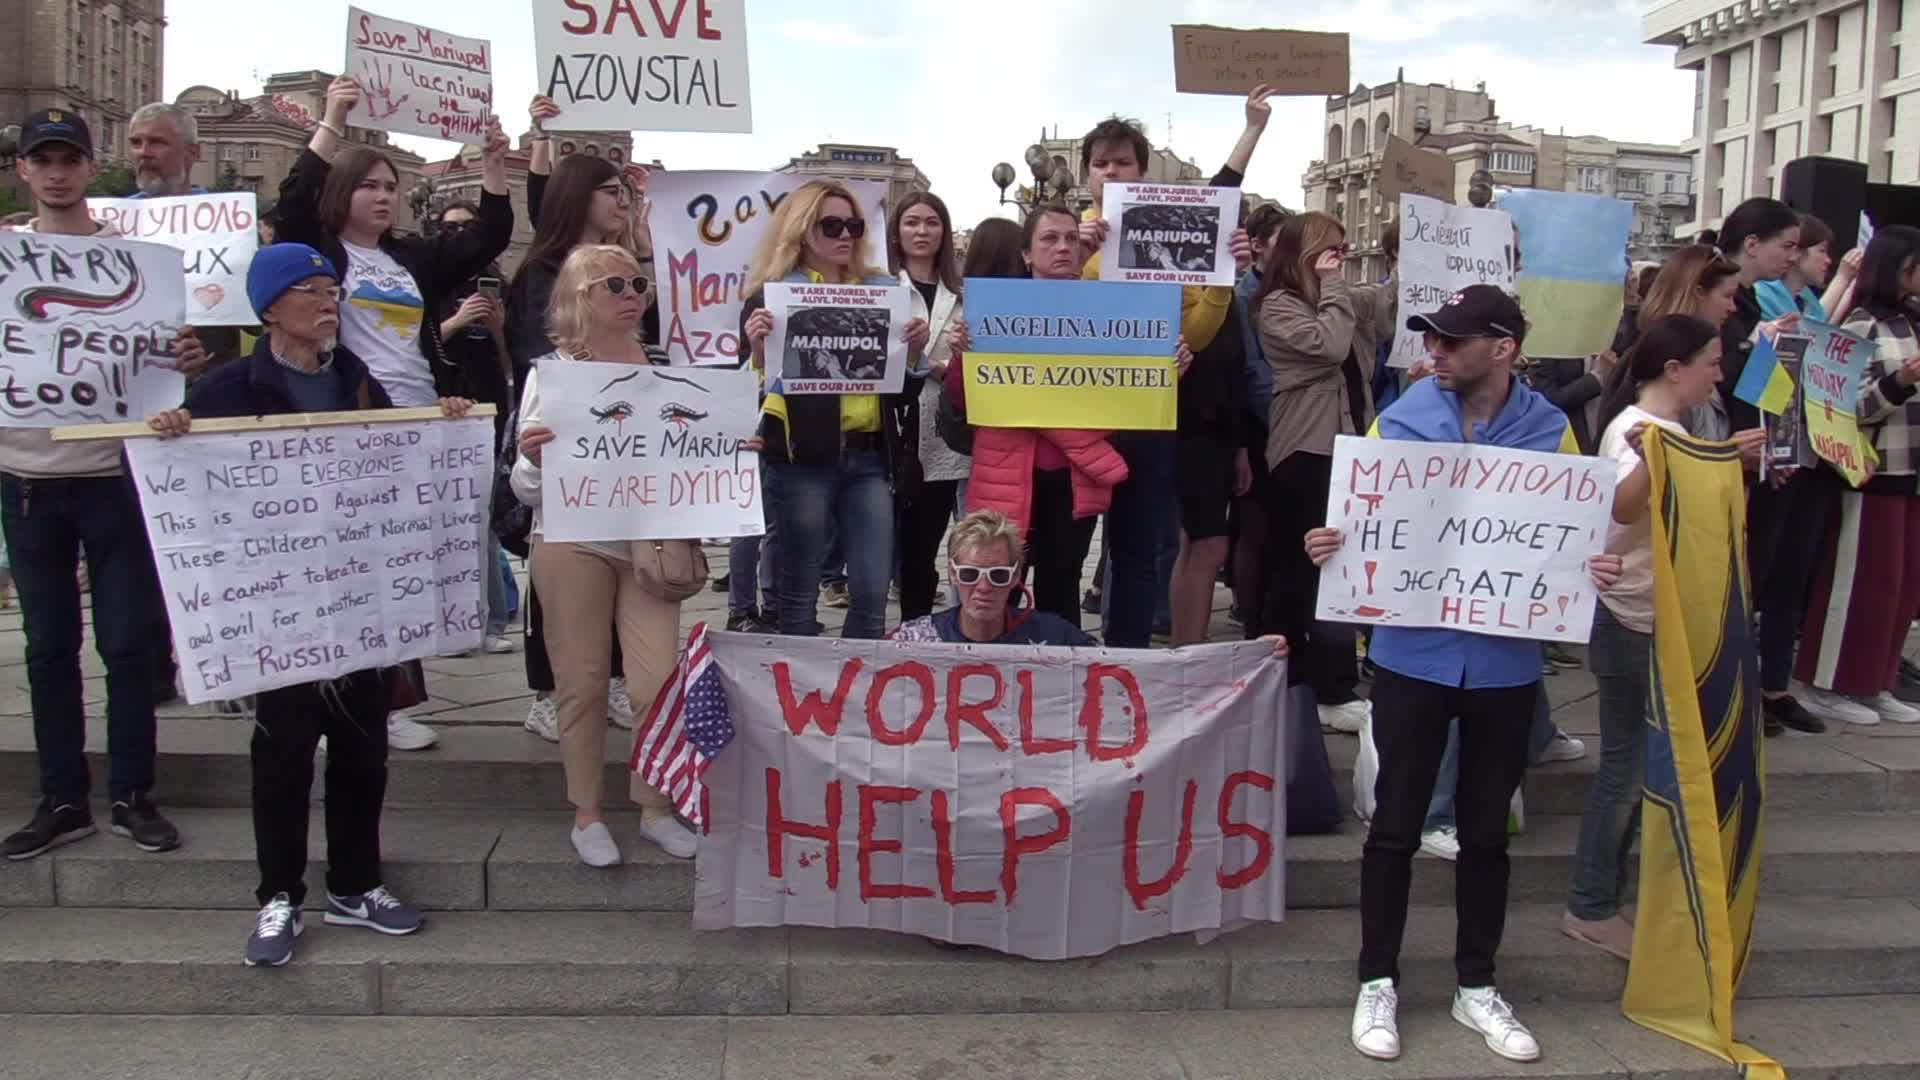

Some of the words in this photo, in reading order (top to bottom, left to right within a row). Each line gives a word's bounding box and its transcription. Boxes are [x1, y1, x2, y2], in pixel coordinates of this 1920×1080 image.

[562, 0, 721, 40] SAVE
[352, 14, 407, 50] Save
[406, 27, 487, 70] Mariupol
[547, 54, 736, 108] AZOVSTAL
[90, 200, 252, 237] РИУПОЛЬ
[687, 189, 788, 246] Sav
[1127, 229, 1211, 244] MARIUPOL
[184, 248, 233, 275] их
[1125, 272, 1152, 281] SAVE
[1153, 272, 1177, 281] OUR
[1178, 273, 1207, 282] LIVES
[667, 247, 748, 313] Mari
[790, 287, 805, 296] WE
[806, 288, 825, 296] ARE
[665, 312, 741, 364] Azo
[792, 335, 881, 350] MARIUPOL
[976, 316, 1098, 338] ANGELINA
[1102, 319, 1169, 340] JOLIE
[1824, 332, 1857, 365] THE
[790, 382, 817, 391] SAVE
[819, 382, 844, 391] OUR
[845, 382, 874, 391] LIVES
[975, 364, 1035, 386] SAVE
[1040, 366, 1172, 389] AZOVSTEEL
[249, 435, 335, 460] PLEASE
[356, 431, 421, 450] WORLD
[572, 434, 647, 460] SAVE
[145, 464, 186, 495] We
[206, 464, 278, 490] NEED
[301, 454, 404, 485] EVERYONE
[430, 444, 486, 470] HERE
[1350, 456, 1597, 502] МАРИУПОЛЬ
[152, 512, 196, 534] This
[213, 510, 232, 525] is
[252, 497, 318, 519] GOOD
[416, 478, 481, 505] EVIL
[559, 475, 599, 508] WE
[608, 474, 656, 508] ARE
[165, 550, 226, 571] These
[244, 534, 327, 558] Children
[335, 525, 372, 544] Want
[381, 518, 433, 538] Normal
[1361, 519, 1409, 552] НЕ
[1438, 516, 1579, 552] МОЖЕТ
[178, 582, 211, 612] We
[386, 536, 480, 568] corruption
[1393, 567, 1548, 600] ЖДАТЬ
[220, 611, 254, 641] evil
[272, 609, 300, 628] for
[1440, 595, 1569, 633] HELP!
[770, 657, 1148, 763] WORLD
[765, 767, 1072, 911] HELP
[1122, 770, 1274, 909] US
